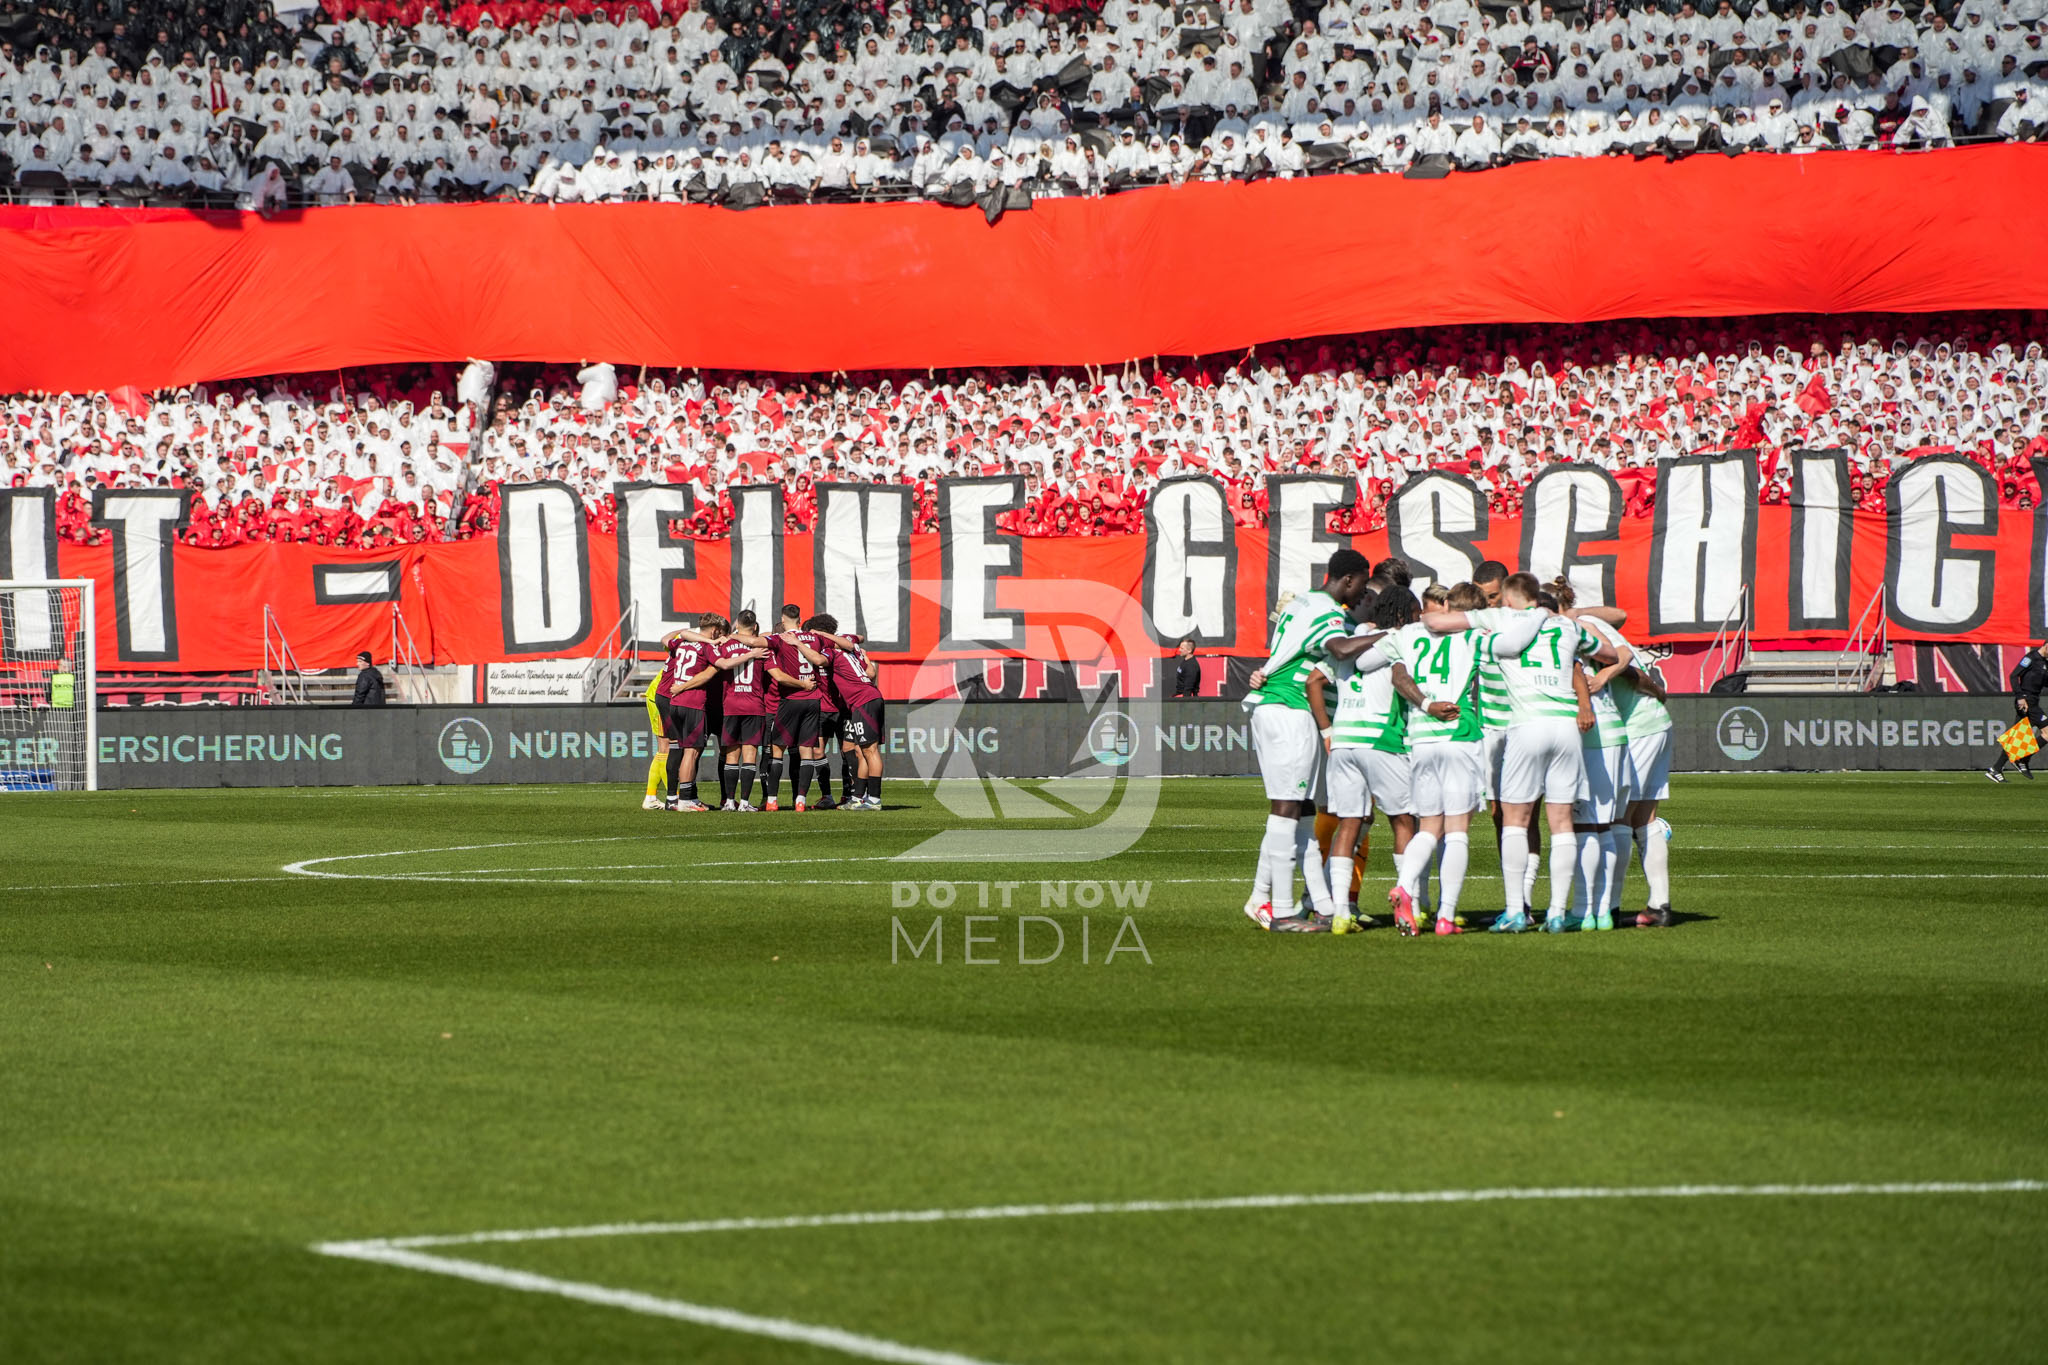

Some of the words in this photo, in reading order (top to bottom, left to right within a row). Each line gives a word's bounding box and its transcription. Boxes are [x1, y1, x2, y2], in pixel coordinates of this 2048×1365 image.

[497, 473, 1026, 655] DEINE
[1141, 445, 2048, 650] GESCHIC
[1413, 636, 1452, 684] 24
[1520, 627, 1563, 669] 27
[674, 648, 697, 680] 32
[731, 653, 755, 685] 10
[1534, 675, 1560, 686] ITTER
[853, 722, 865, 735] 18
[1155, 723, 1256, 751] NÜRN
[1784, 718, 2007, 747] NÜRNBERGER
[98, 733, 343, 763] ERSICHERUNG
[509, 730, 657, 759] NÜRNBE
